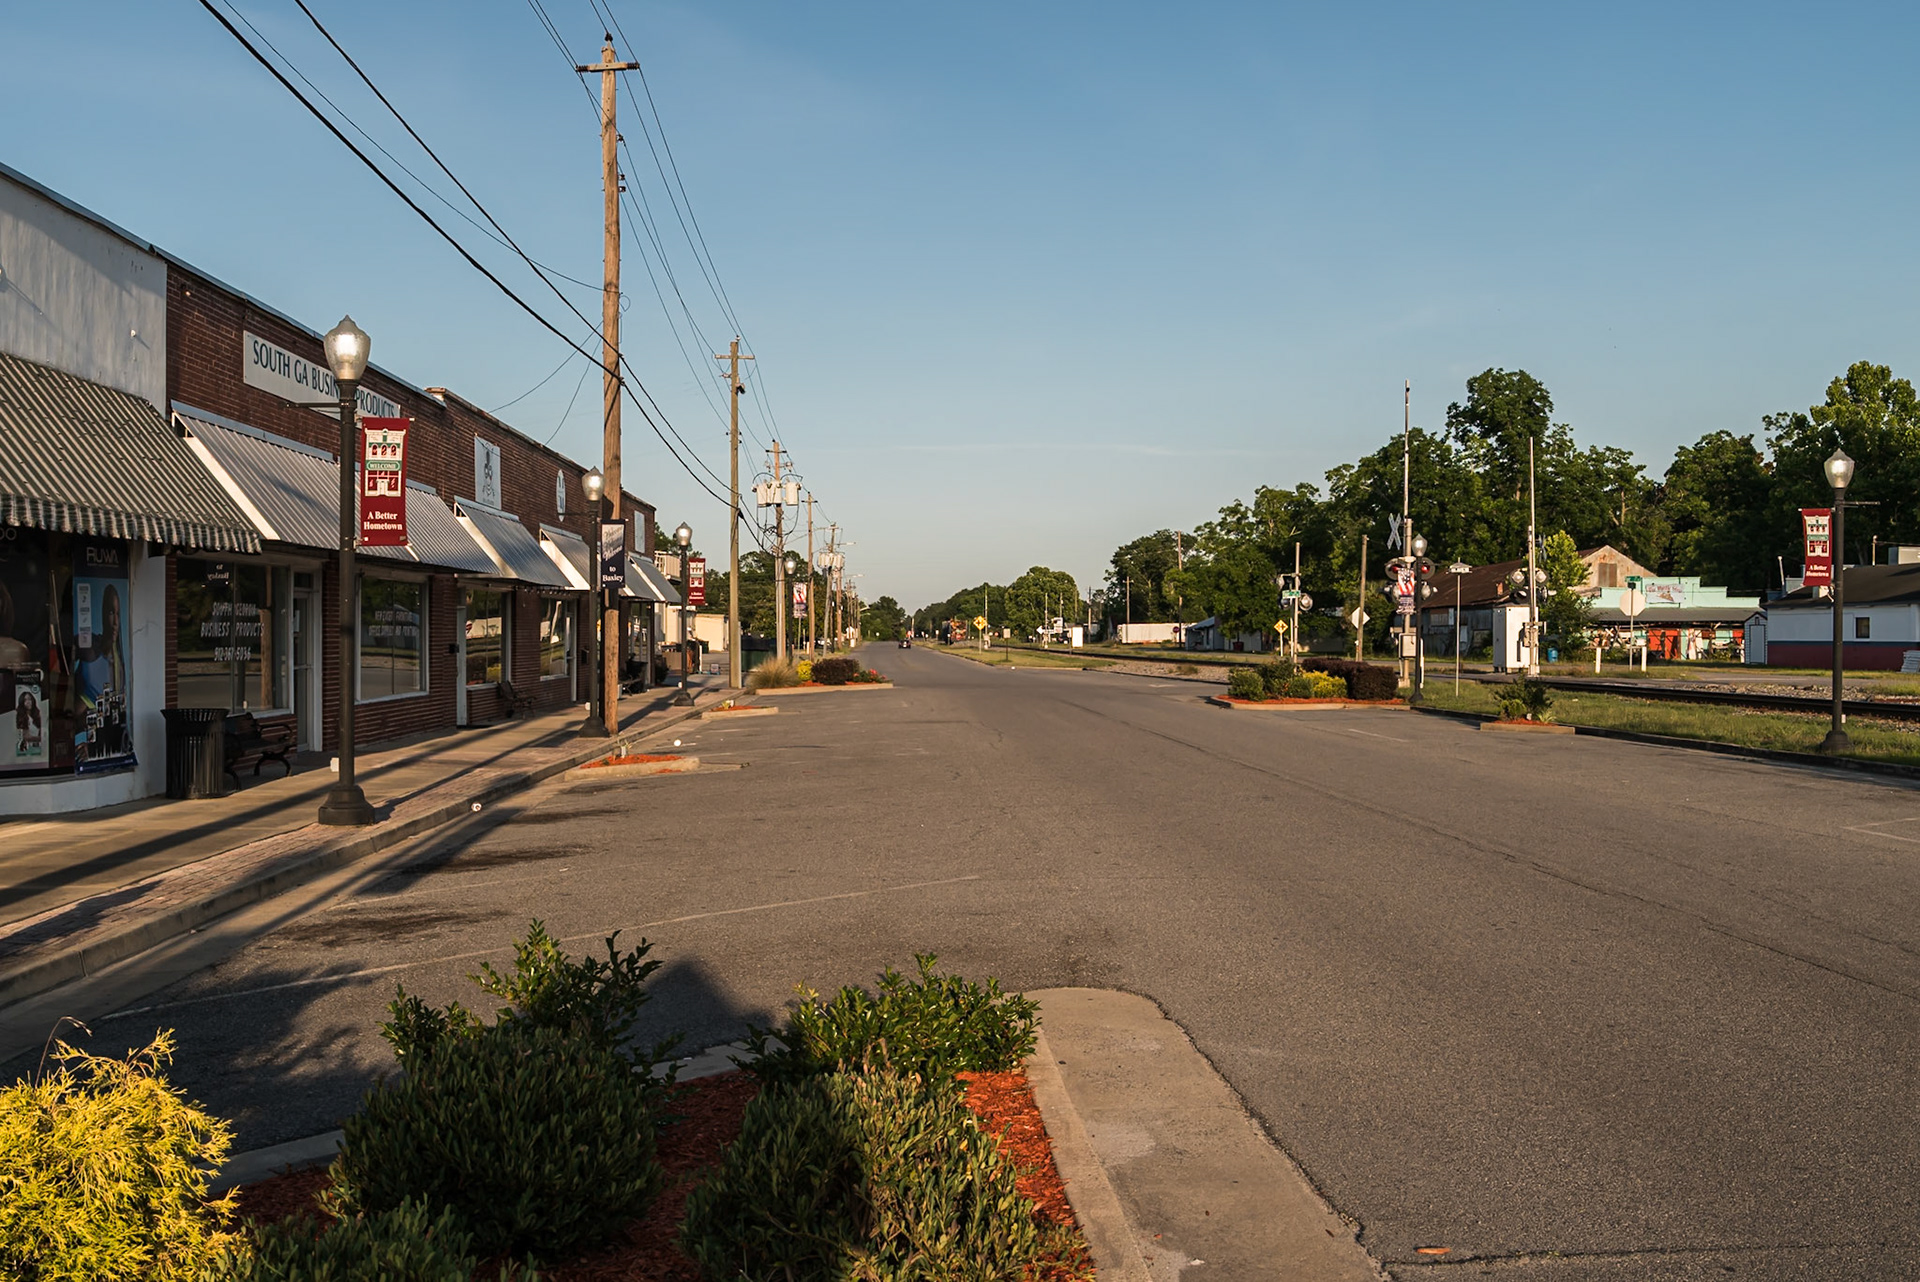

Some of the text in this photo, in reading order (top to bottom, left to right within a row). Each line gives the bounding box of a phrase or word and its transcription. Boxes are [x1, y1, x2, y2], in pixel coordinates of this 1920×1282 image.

[253, 339, 290, 379] SOUTH
[294, 359, 309, 387] GA
[367, 511, 398, 520] A Better
[363, 521, 403, 531] Hometown
[602, 574, 623, 583] Baxley
